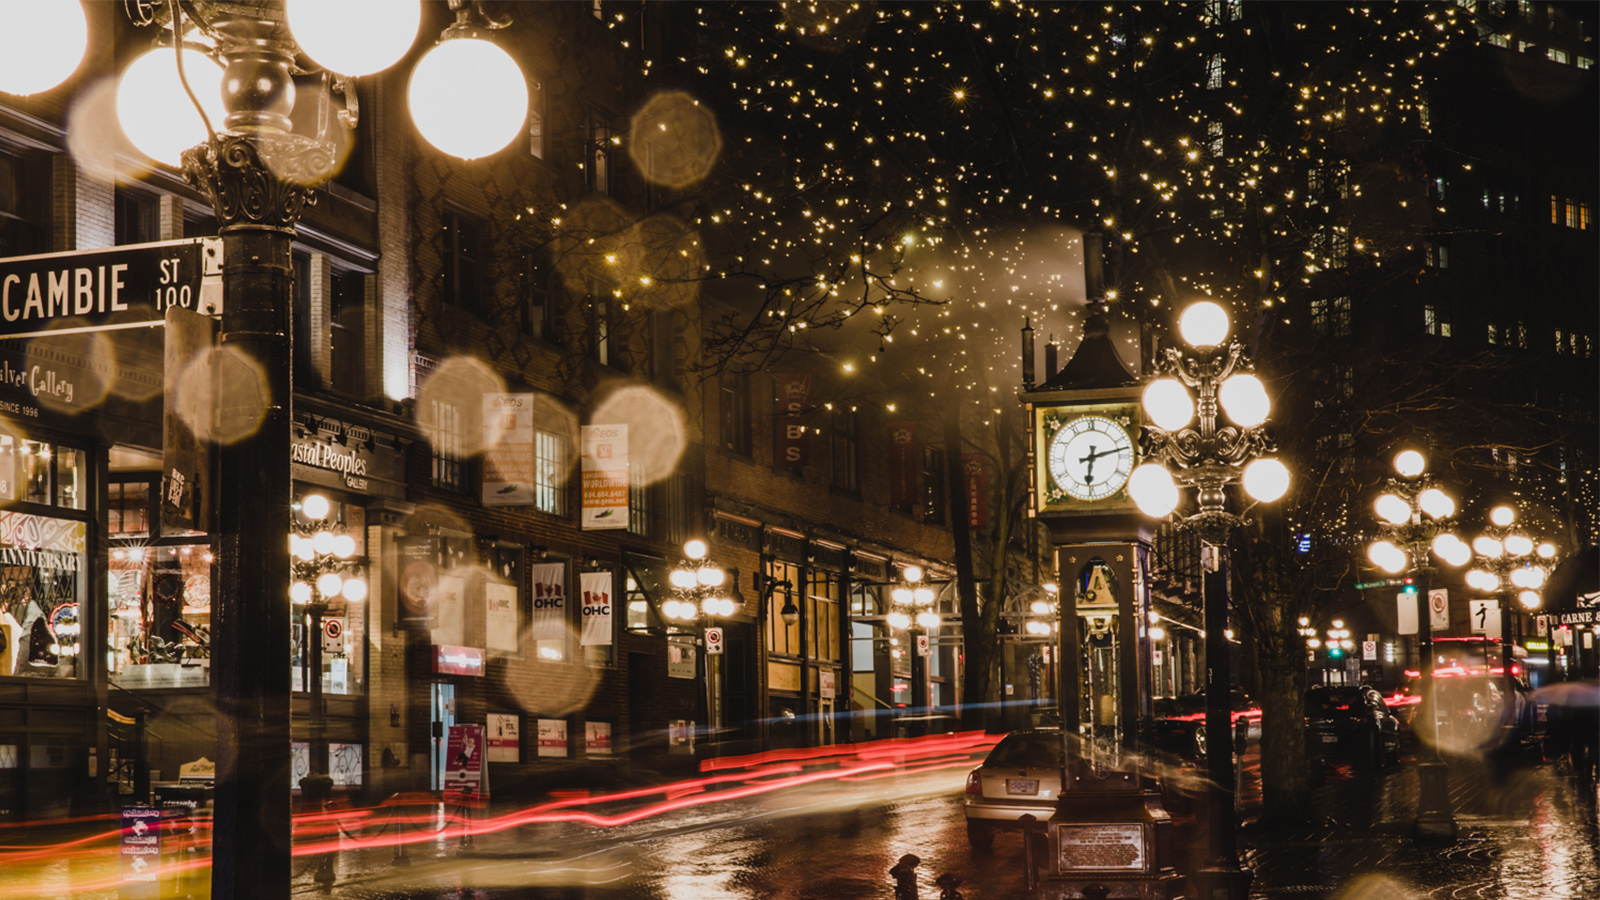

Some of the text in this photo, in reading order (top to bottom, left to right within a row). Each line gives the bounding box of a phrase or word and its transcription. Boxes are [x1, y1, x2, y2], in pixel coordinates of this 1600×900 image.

[160, 258, 180, 285] ST
[3, 263, 128, 322] CAMBIE
[156, 285, 192, 313] 100
[31, 365, 73, 402] Gallery
[23, 406, 38, 417] 1996
[291, 442, 366, 478] astal Peoples
[485, 452, 530, 462] WORLDWIDE
[347, 477, 368, 490] GALLERY
[583, 479, 627, 488] WORLDWIDE
[584, 490, 626, 498] 604.684.6407
[584, 498, 626, 506] www.geos.net
[0, 547, 81, 572] ANNIVERSARY
[534, 598, 563, 608] OHC
[583, 606, 610, 616] OHC
[1561, 611, 1593, 624] CARNE
